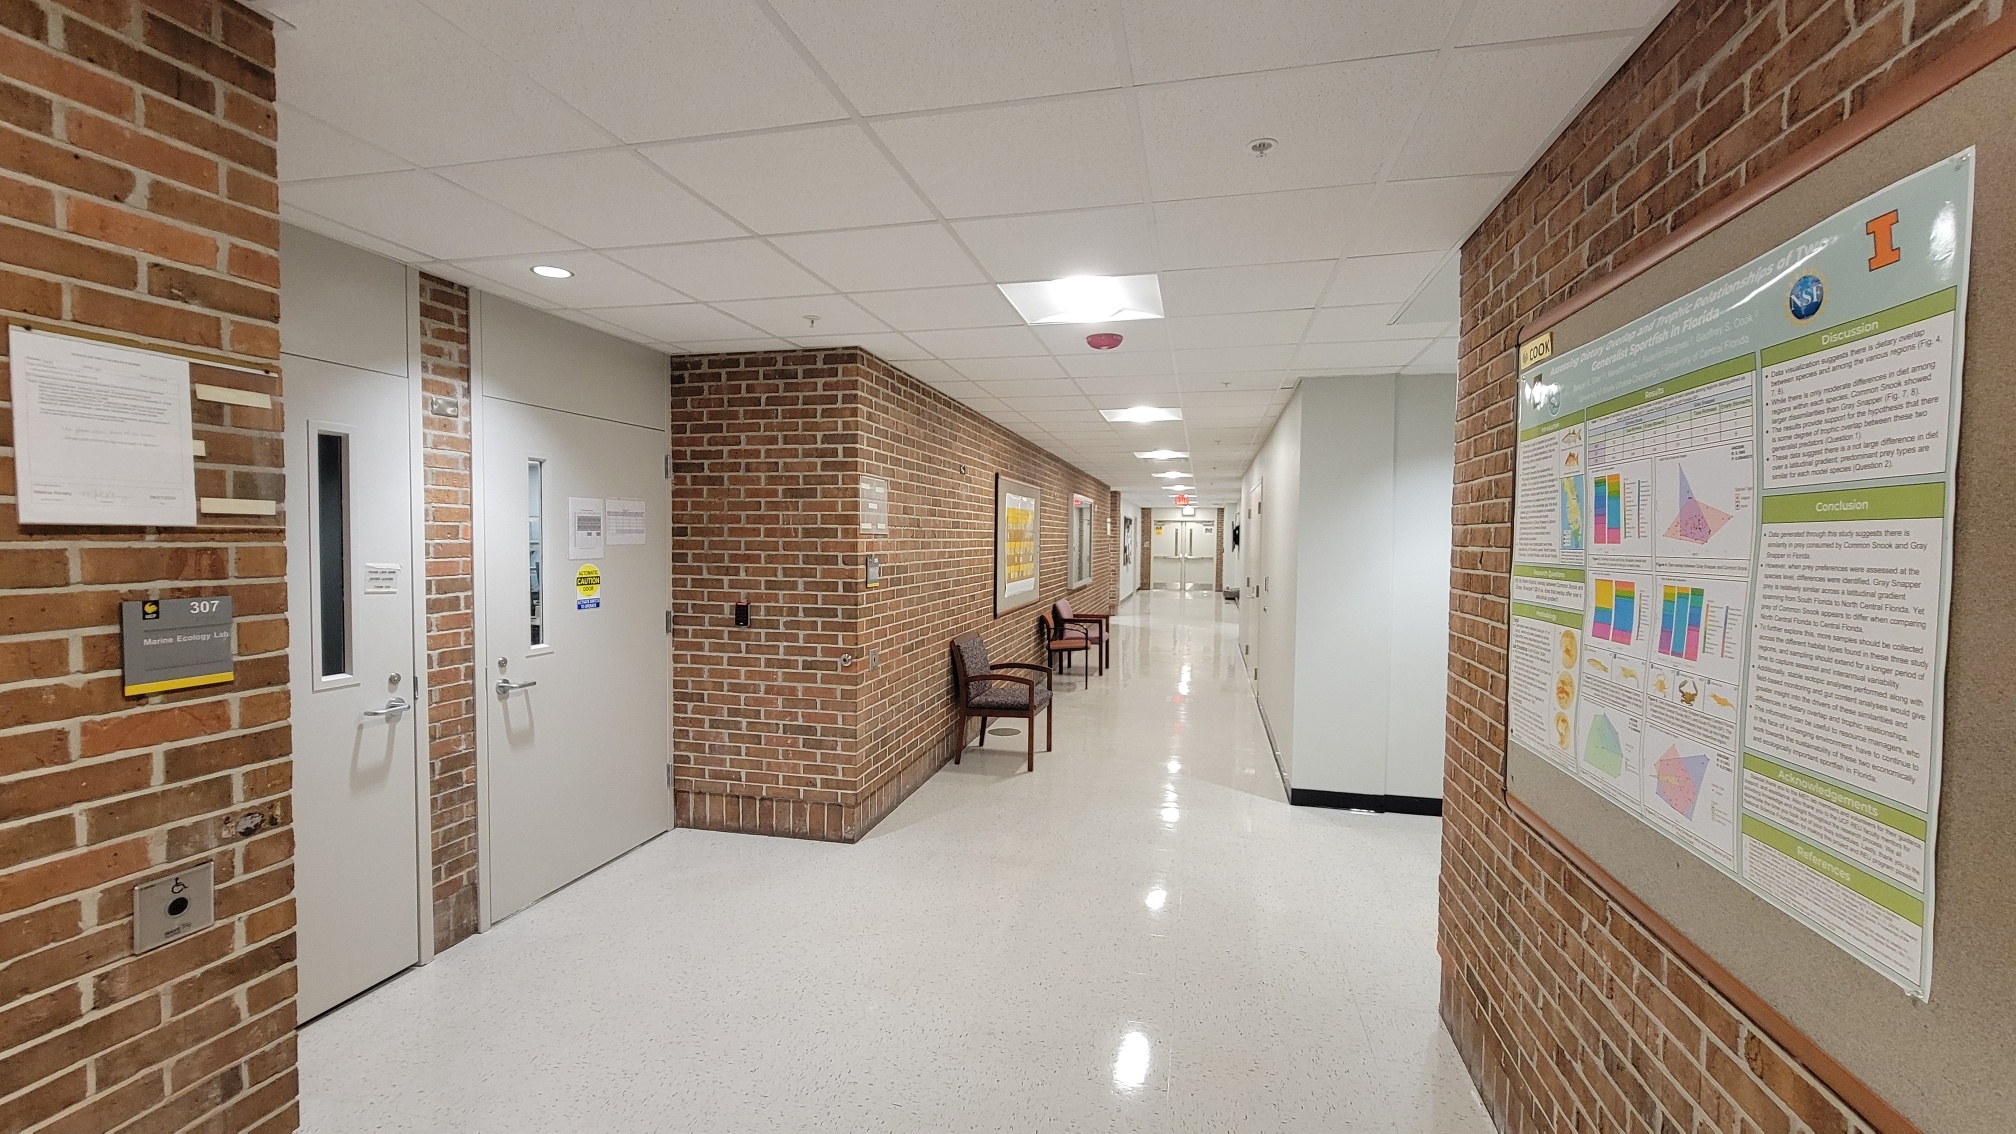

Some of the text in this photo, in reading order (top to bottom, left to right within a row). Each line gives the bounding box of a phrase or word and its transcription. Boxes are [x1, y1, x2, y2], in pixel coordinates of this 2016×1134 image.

[1866, 209, 1900, 272] I
[1790, 284, 1822, 310] NSF
[1550, 357, 1580, 376] Assessing
[1580, 344, 1604, 362] Dietary
[1606, 331, 1636, 350] Overlap
[1637, 320, 1656, 336] and
[1656, 303, 1692, 328] Trophic
[1694, 262, 1773, 310] Relationships
[1777, 252, 1793, 270] of
[1592, 308, 1719, 371] Generalist Sportfish in Florida
[1821, 320, 1878, 346] Discussion
[1530, 340, 1550, 361] COOK
[1770, 368, 1783, 378] Data
[1785, 358, 1819, 373] visualization
[1821, 349, 1848, 365] suggests
[1850, 344, 1866, 356] there
[1874, 336, 1896, 350] dietary
[1898, 327, 1924, 344] overlap
[1770, 375, 1794, 387] between
[1795, 368, 1817, 382] species
[1818, 365, 1830, 374] and
[1831, 360, 1852, 372] among
[1853, 356, 1863, 365] the
[1865, 349, 1888, 362] various
[1890, 342, 1915, 357] regions
[1645, 387, 1664, 398] Results
[1771, 396, 1786, 405] While
[1787, 392, 1802, 401] there
[1809, 387, 1821, 398] only
[1823, 380, 1851, 393] moderate
[1852, 372, 1886, 386] differences
[1896, 366, 1909, 376] diet
[1910, 361, 1935, 374] among
[1771, 404, 1791, 416] regions
[1792, 400, 1808, 410] within
[1810, 396, 1824, 406] each
[1850, 384, 1878, 397] Common
[1880, 379, 1901, 391] Snook
[1904, 372, 1931, 386] showed
[1771, 415, 1786, 425] larger
[1788, 407, 1824, 420] dissimilarities
[1826, 404, 1839, 413] than
[1840, 400, 1854, 411] Gray
[1856, 394, 1882, 408] Snapper
[1783, 421, 1801, 431] results
[1802, 417, 1822, 428] provide
[1824, 412, 1845, 424] support
[1856, 408, 1866, 417] the
[1867, 401, 1903, 416] hypothesis
[1905, 398, 1919, 408] that
[1920, 394, 1938, 405] there
[1793, 429, 1812, 440] degree
[1820, 424, 1839, 435] trophic
[1840, 420, 1862, 432] overlap
[1864, 415, 1891, 426] between
[1893, 411, 1912, 421] these
[1914, 408, 1927, 418] two
[1771, 442, 1797, 453] generalist
[1798, 437, 1823, 449] predators
[1824, 432, 1853, 445] (Question
[1772, 453, 1788, 461] These
[1802, 447, 1822, 458] suggest
[1824, 445, 1838, 453] there
[1852, 442, 1861, 450] not
[1862, 439, 1879, 449] large
[1880, 434, 1915, 445] difference
[1925, 430, 1938, 439] diet
[1789, 459, 1813, 468] latitudinal
[1840, 450, 1878, 463] predominant
[1879, 449, 1894, 458] prey
[1896, 445, 1915, 456] types
[1810, 467, 1828, 475] model
[1829, 464, 1851, 474] species
[1852, 460, 1882, 472] (Question
[1815, 499, 1868, 512] Conclusion
[1855, 529, 1882, 537] suggests
[1910, 542, 1927, 550] Gray
[190, 601, 219, 614] 307
[144, 637, 174, 646] Marine
[177, 633, 211, 642] Ecology
[1778, 769, 1878, 817] Acknowledgements
[1797, 846, 1850, 881] References
